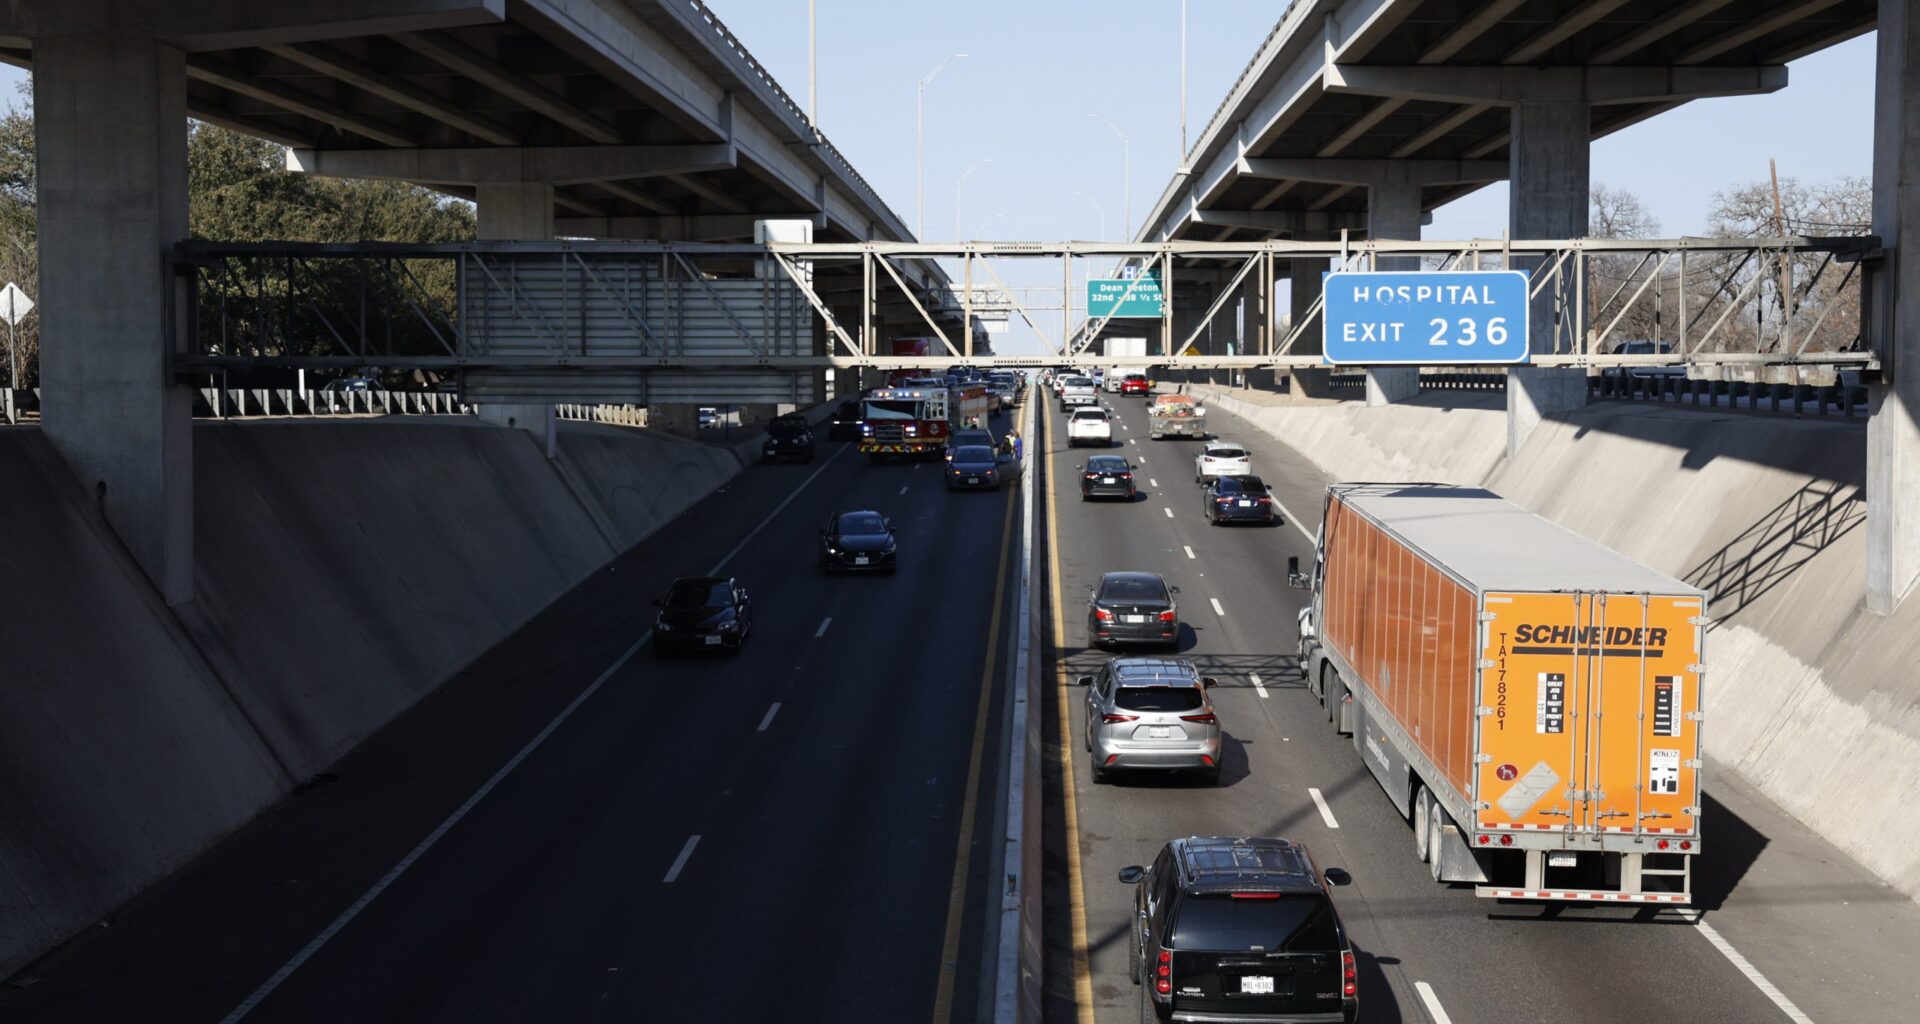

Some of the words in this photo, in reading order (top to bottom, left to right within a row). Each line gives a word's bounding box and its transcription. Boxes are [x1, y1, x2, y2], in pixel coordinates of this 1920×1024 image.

[1092, 293, 1114, 302] 32nd
[1100, 284, 1123, 292] Dean
[1127, 284, 1159, 292] eeton
[1353, 285, 1496, 305] HOSPITAL
[1343, 322, 1405, 342] EXIT
[1429, 317, 1509, 346] 236
[1514, 623, 1668, 646] SCHNEIDER
[1497, 632, 1507, 731] TA178261
